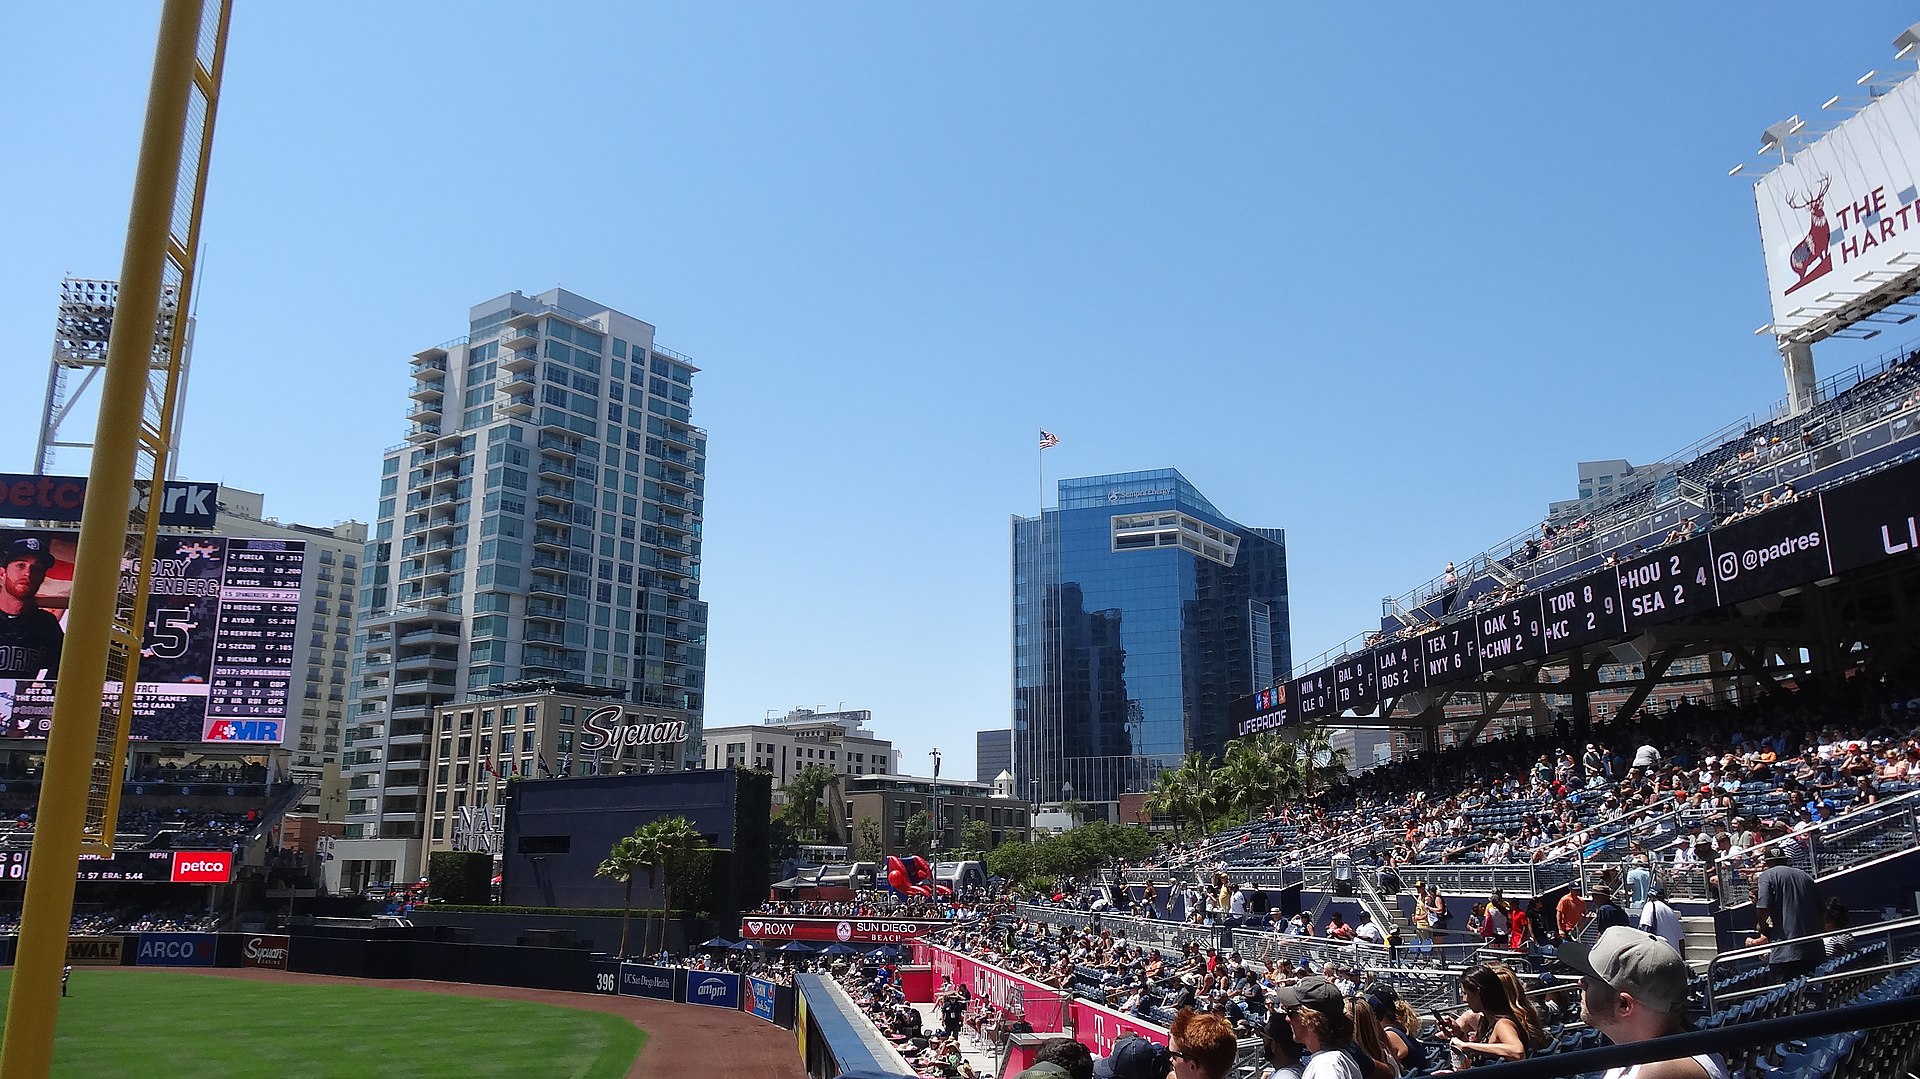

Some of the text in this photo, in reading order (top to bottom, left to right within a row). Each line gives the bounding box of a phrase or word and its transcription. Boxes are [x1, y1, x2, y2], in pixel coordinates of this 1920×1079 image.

[1836, 185, 1886, 231] THE
[1742, 531, 1820, 570] @padres
[1628, 555, 1682, 589] HOU 2
[1696, 566, 1707, 587] 4
[1549, 585, 1593, 615] TOR 8
[1604, 596, 1614, 615] 9
[1632, 584, 1685, 617] SEA 2
[1484, 609, 1521, 636] OAK 5
[1531, 620, 1538, 637] 9
[1552, 611, 1596, 640] KC 2
[1428, 630, 1459, 654] TEX 7
[1467, 640, 1474, 657] F
[1486, 634, 1523, 659] CHW 2
[1380, 648, 1408, 670] LAA 4
[1413, 658, 1420, 673] F
[1429, 653, 1461, 676] NYY 6
[1339, 663, 1363, 682] BAL 8
[1368, 673, 1373, 686] F
[1381, 669, 1409, 690] BOS 2
[136, 685, 160, 693] FACT
[1301, 677, 1323, 695] MIN 4
[1326, 686, 1331, 699] F
[1340, 683, 1364, 702] TB 5
[1302, 698, 1315, 712] CLE
[207, 720, 278, 740] AMR
[580, 704, 688, 760] Sycuan
[1238, 709, 1287, 736] LIFEPROOF
[180, 860, 223, 875] petco
[764, 923, 917, 935] ROXY SUN DIEGO
[68, 941, 119, 957] WALT
[140, 941, 194, 958] ARCO
[244, 938, 286, 964] Sycuan
[596, 973, 614, 992] 396
[697, 983, 727, 1000] ampm
